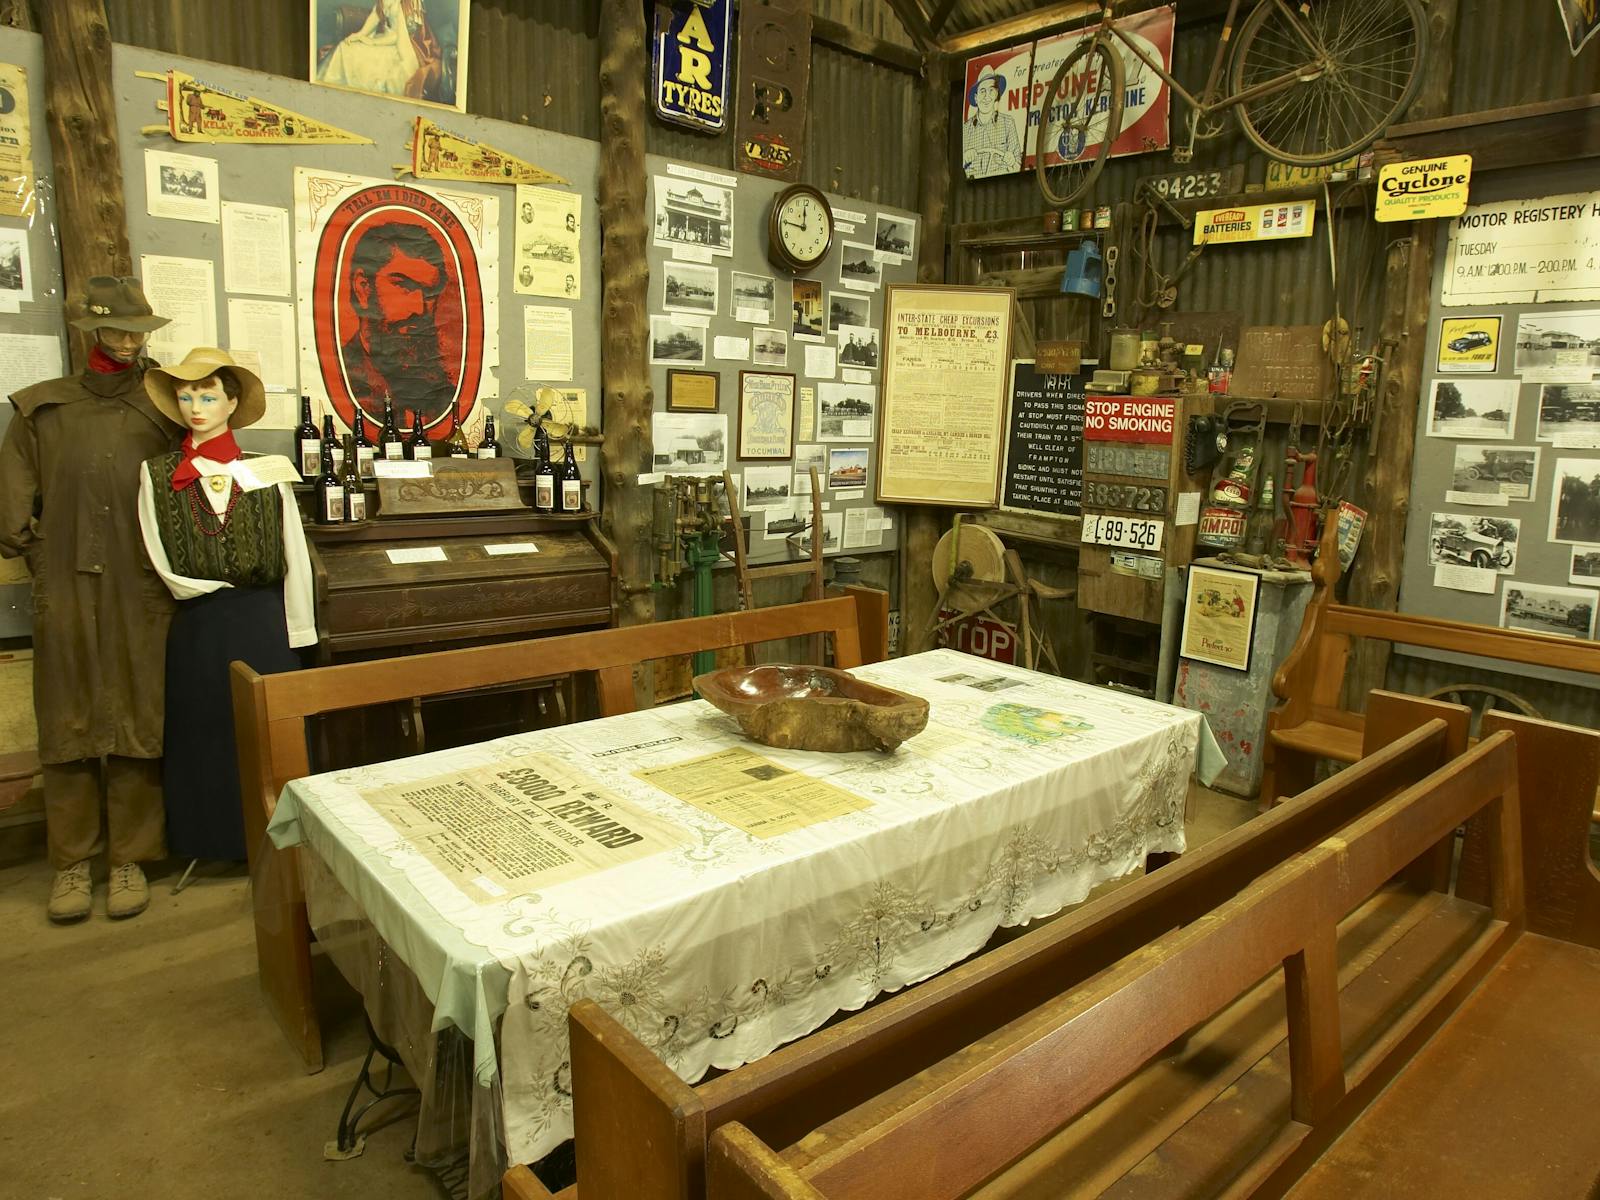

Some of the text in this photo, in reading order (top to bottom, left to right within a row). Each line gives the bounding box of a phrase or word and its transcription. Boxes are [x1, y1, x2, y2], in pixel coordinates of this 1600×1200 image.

[663, 80, 721, 117] TYRES
[203, 119, 234, 130] KELLY
[235, 128, 283, 138] COUNTRY
[1401, 162, 1448, 175] GENUINE
[1382, 173, 1466, 197] Cyclone
[402, 190, 427, 206] DIED
[1384, 197, 1416, 206] QUALITY
[1418, 192, 1460, 202] PRODUCTS
[1458, 212, 1508, 230] MOTOR
[1513, 204, 1586, 225] REGISTERY
[1203, 221, 1252, 234] BATTERIES
[1459, 242, 1498, 257] TUESDAY
[939, 315, 959, 325] CHEAP
[962, 315, 1000, 327] EXCURSIONS
[897, 326, 908, 335] TO
[1086, 401, 1174, 417] STOP ENGINE
[1020, 422, 1054, 430] CAUTIOUSLY
[1085, 416, 1172, 432] NO SMOKING
[1029, 454, 1069, 463] FRAMPTON
[1013, 473, 1037, 482] RESTART
[1039, 476, 1054, 484] UNTIL
[1034, 496, 1051, 504] PLACE
[485, 782, 526, 807] ROBBERY
[496, 768, 567, 801] £8000
[547, 800, 644, 849] REWARD
